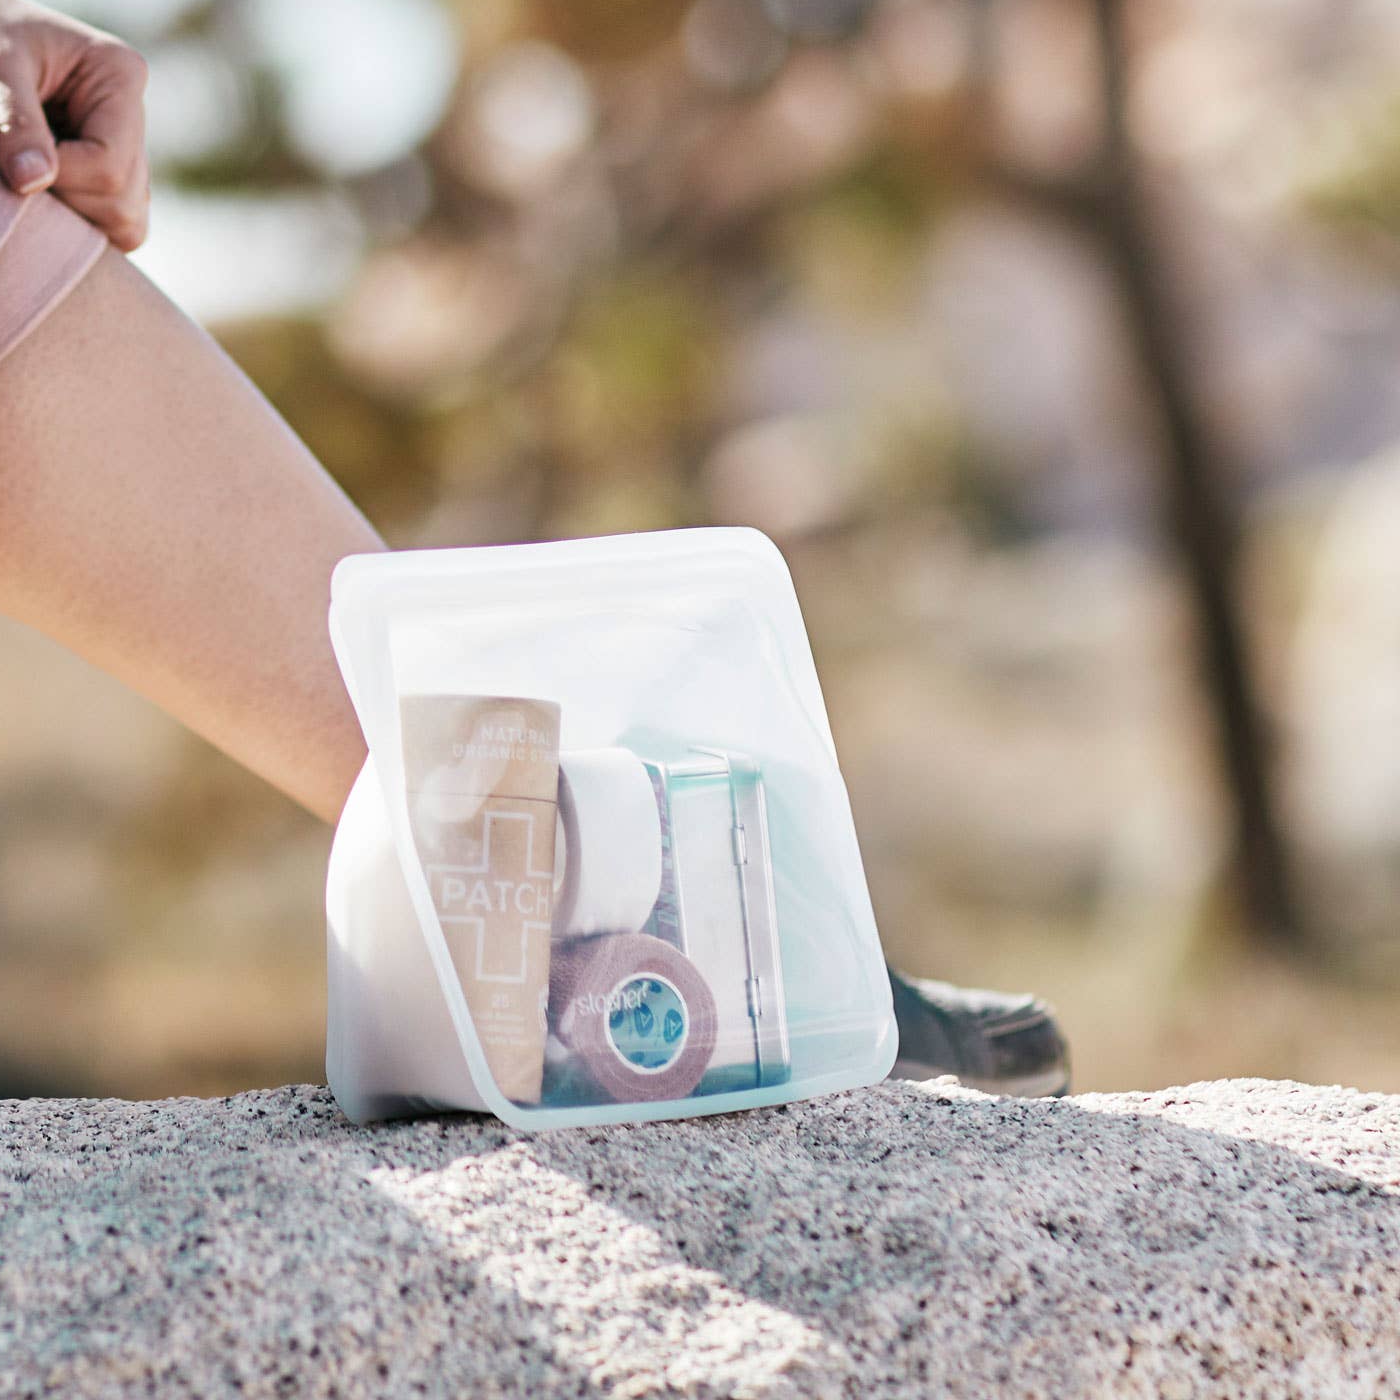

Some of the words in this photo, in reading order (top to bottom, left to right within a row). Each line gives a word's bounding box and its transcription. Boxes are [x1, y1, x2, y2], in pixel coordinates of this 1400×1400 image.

[481, 724, 552, 746] NATURAL
[452, 743, 526, 761] ORGANIC
[441, 877, 549, 917] PATCH
